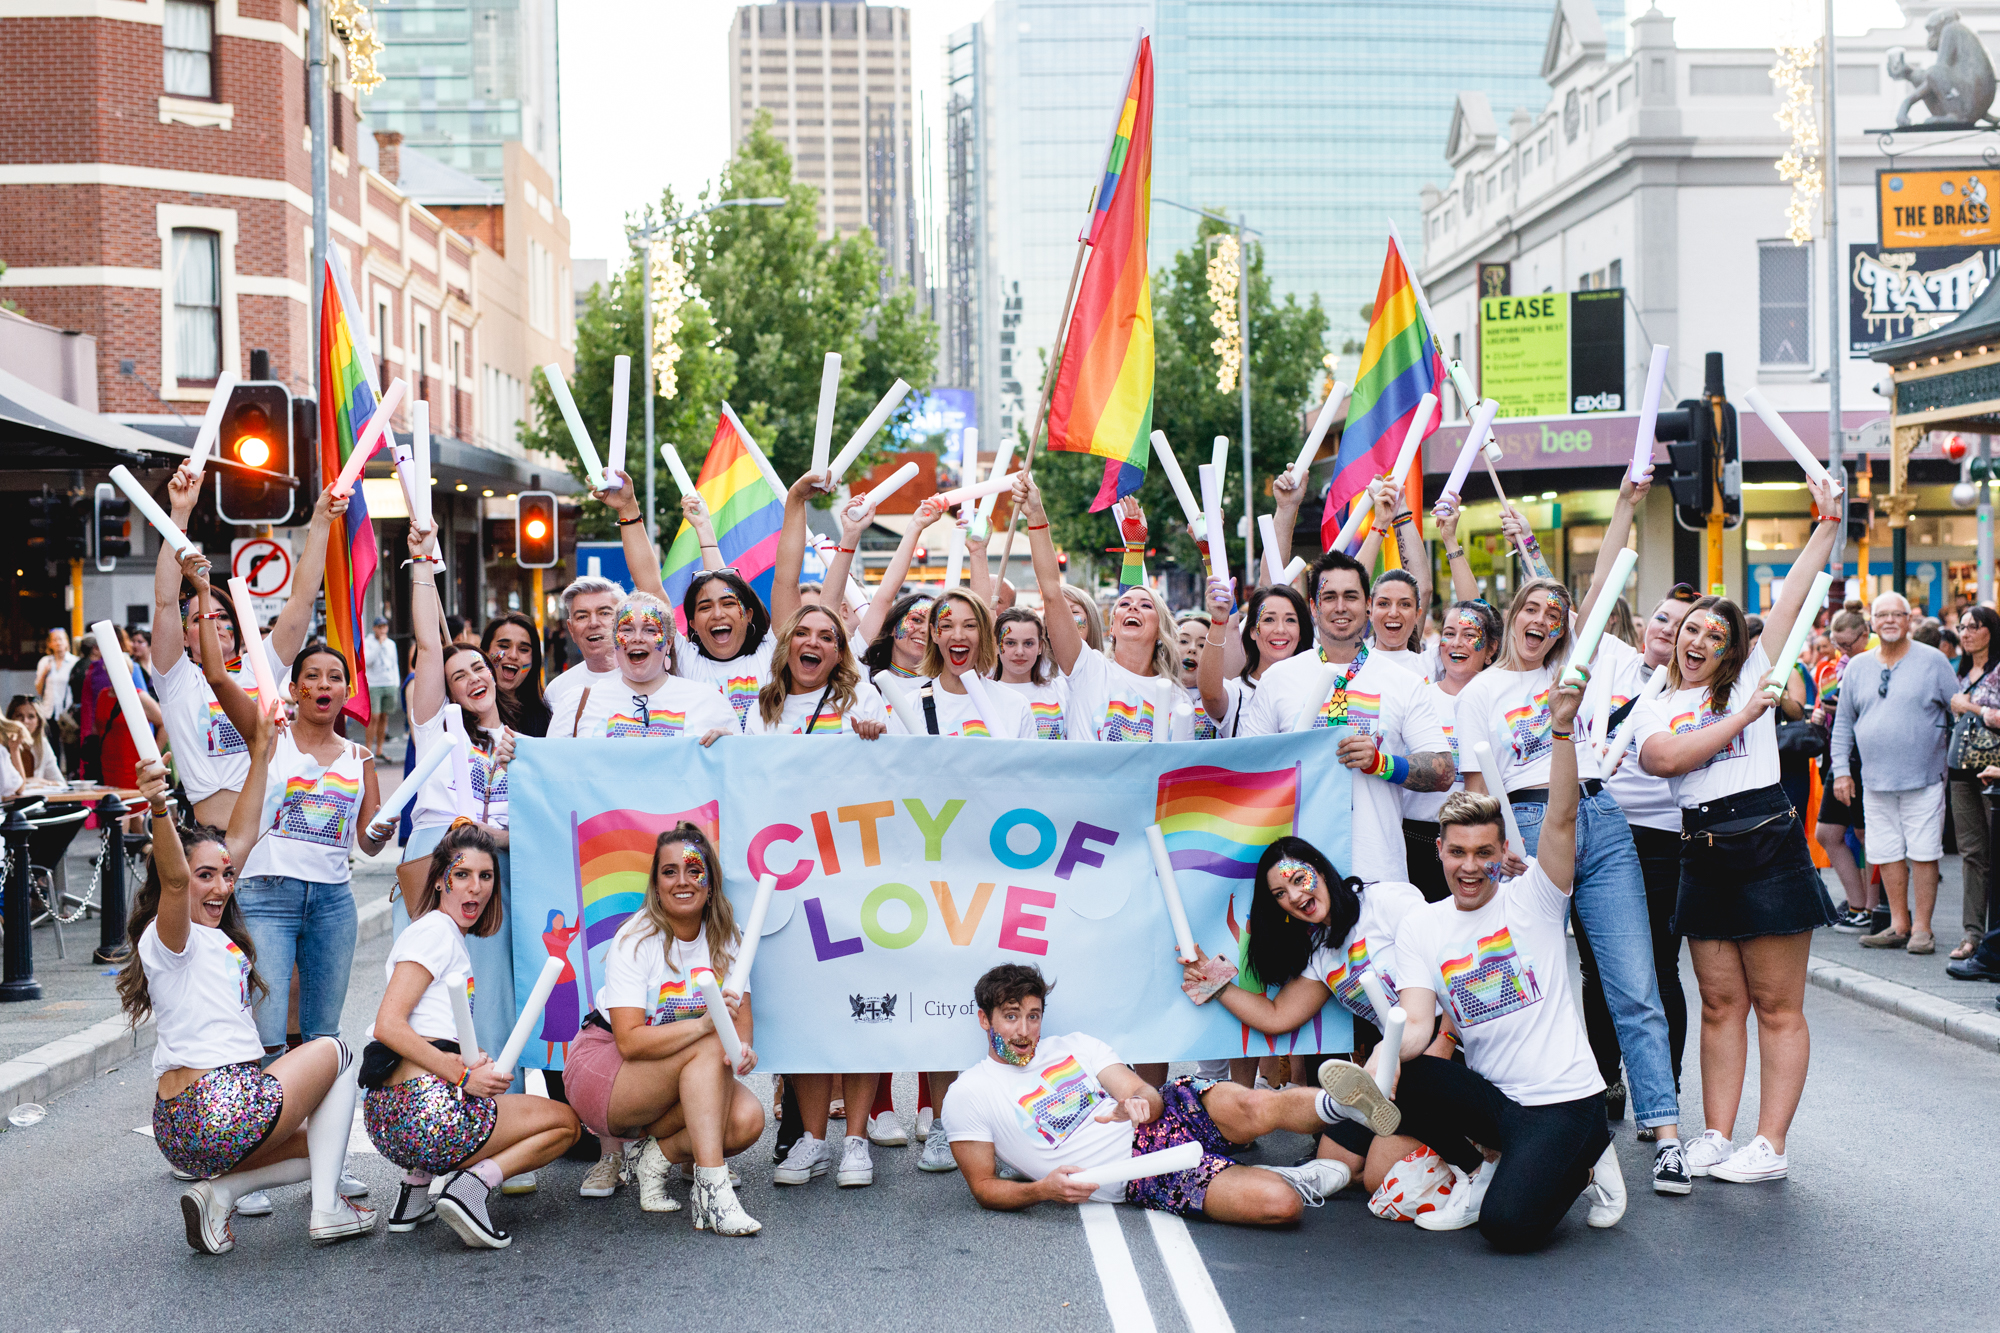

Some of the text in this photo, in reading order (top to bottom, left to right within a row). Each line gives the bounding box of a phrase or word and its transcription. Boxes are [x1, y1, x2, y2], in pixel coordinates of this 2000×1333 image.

[1893, 203, 1990, 227] THE BRASS
[1486, 299, 1554, 320] LEASE
[1574, 391, 1621, 411] axia
[747, 798, 1120, 891] CITY OF
[803, 880, 1057, 962] LOVE
[924, 999, 975, 1019] City of
